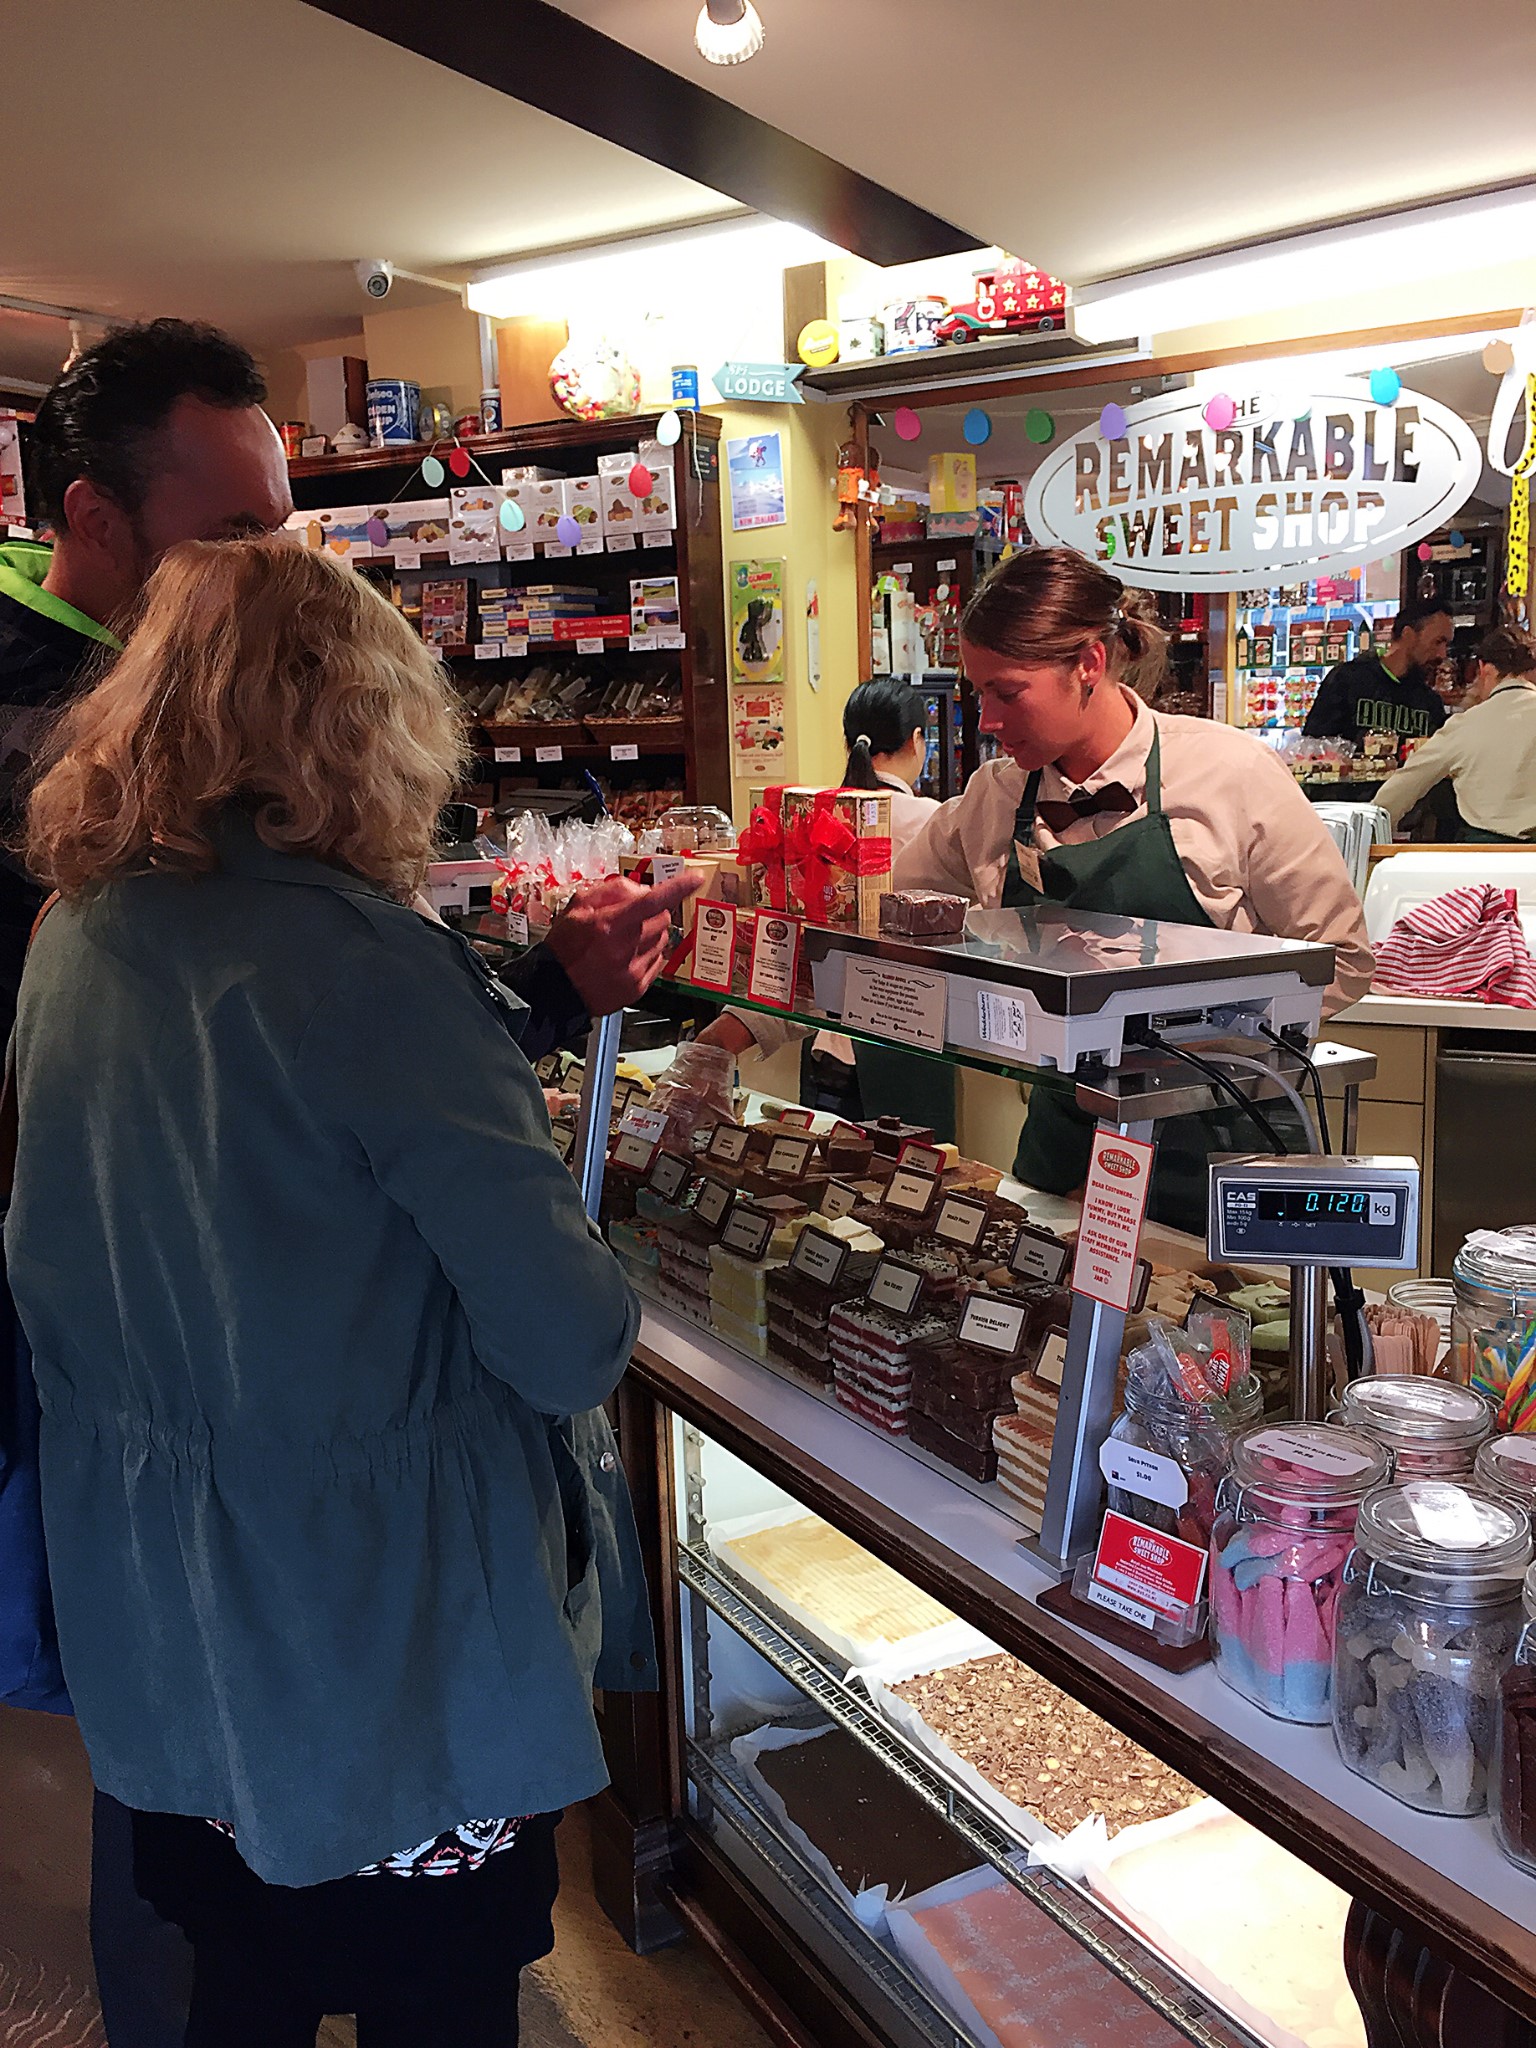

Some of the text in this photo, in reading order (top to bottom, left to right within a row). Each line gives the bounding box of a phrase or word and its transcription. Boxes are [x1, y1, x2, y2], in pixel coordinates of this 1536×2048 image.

[724, 377, 786, 396] LODGE
[1233, 402, 1260, 417] HE
[1075, 406, 1421, 516] REMARKABLE
[1095, 490, 1388, 561] SWEET SHOP
[1102, 1151, 1136, 1170] REMARKABLE
[1092, 1180, 1106, 1190] DEAR
[1098, 1198, 1114, 1208] KNOW
[1116, 1204, 1130, 1214] LOOK
[1227, 1192, 1256, 1201] CAS
[1305, 1193, 1364, 1212] 0.120
[1107, 1210, 1117, 1218] BUT
[1118, 1213, 1136, 1226] PLEASE
[1374, 1202, 1390, 1216] kg
[1088, 1212, 1132, 1232] DO NOT OPEN ME.
[1082, 1236, 1132, 1259] STAFF MEMBERS FOR
[1088, 1229, 1098, 1238] ASK
[1098, 1232, 1108, 1240] ONE
[1116, 1239, 1128, 1248] OUR
[970, 1313, 1010, 1329] TURKISH DELIGHT
[1136, 1471, 1152, 1482] $1.00
[1132, 1536, 1170, 1560] REMARKABLE
[1134, 1546, 1165, 1564] SWEET SHOP
[1096, 1592, 1147, 1622] PLEASE TAKE ONE
